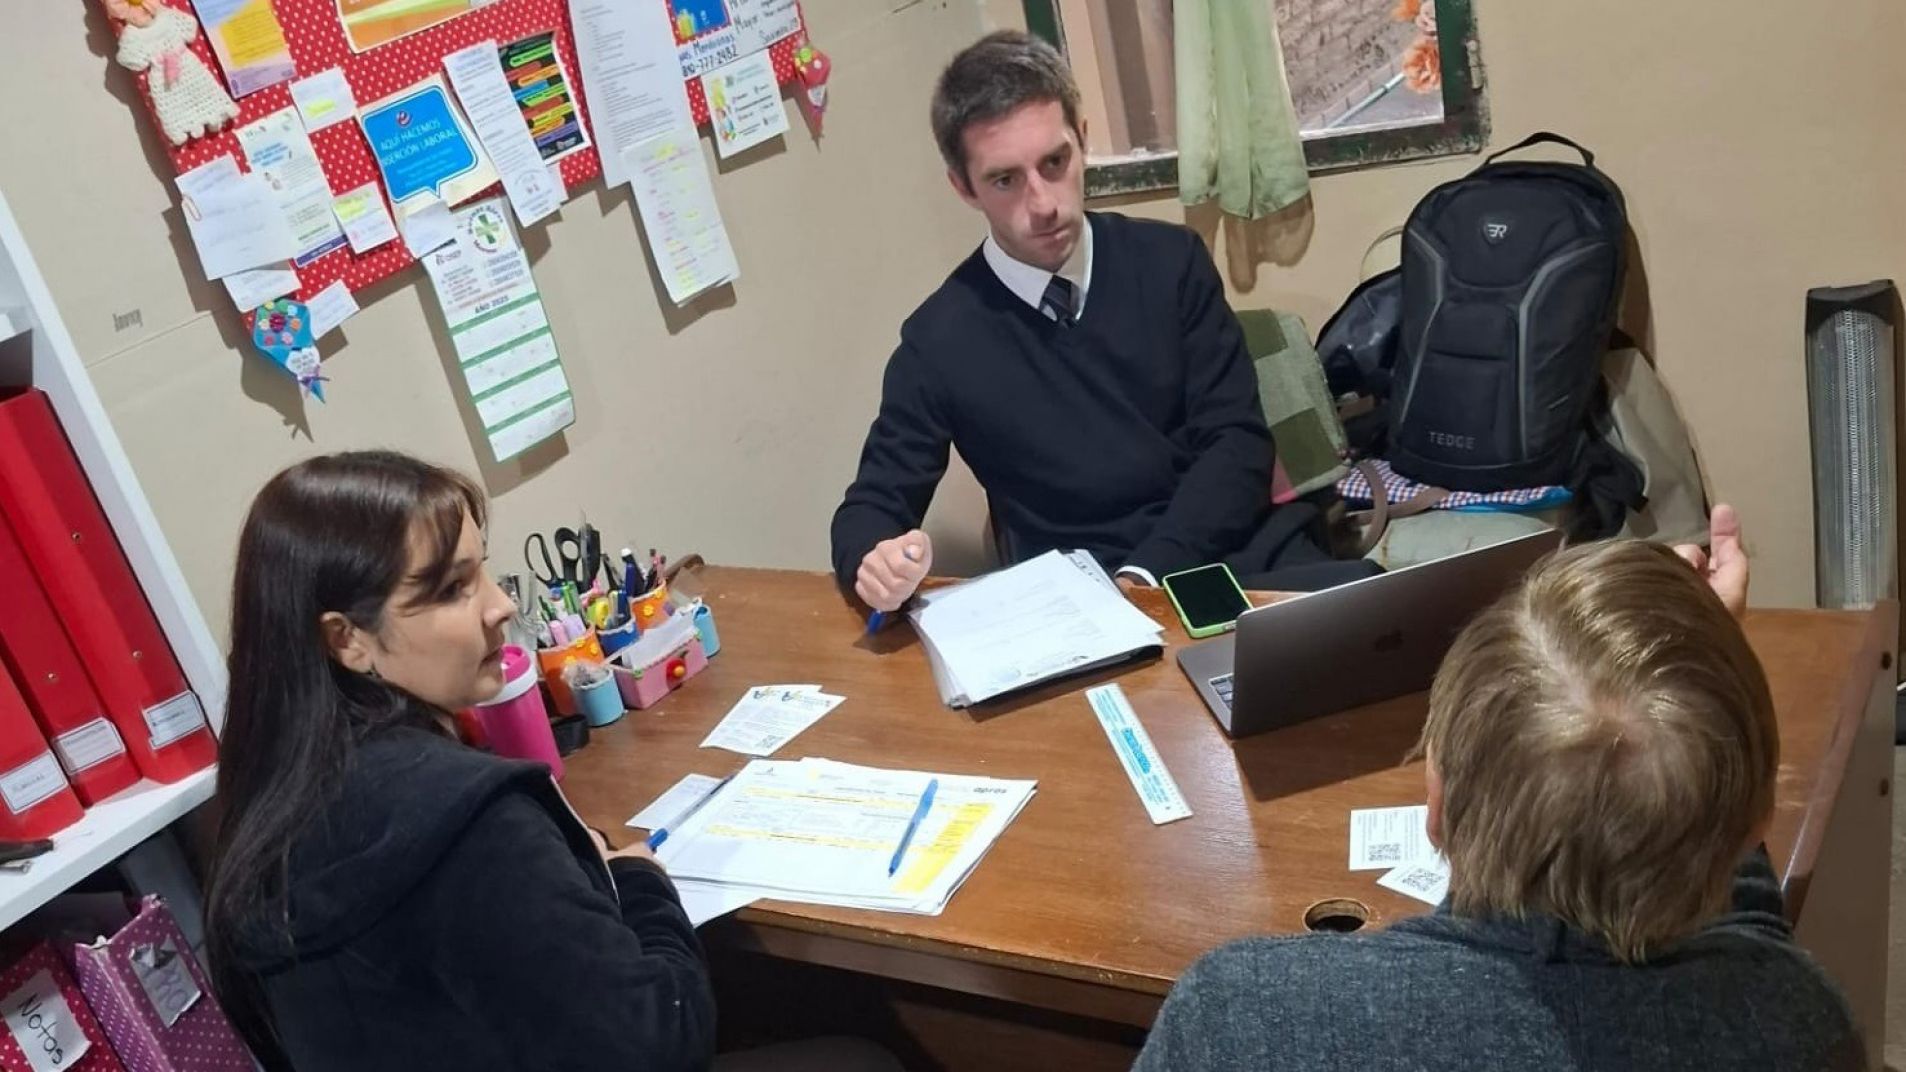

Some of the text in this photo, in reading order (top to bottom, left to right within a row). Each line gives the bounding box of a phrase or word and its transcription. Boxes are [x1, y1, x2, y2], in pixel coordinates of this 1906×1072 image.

[401, 117, 441, 142] HACEMOS
[1429, 431, 1475, 450] TEDGE
[18, 992, 63, 1066] Notas
